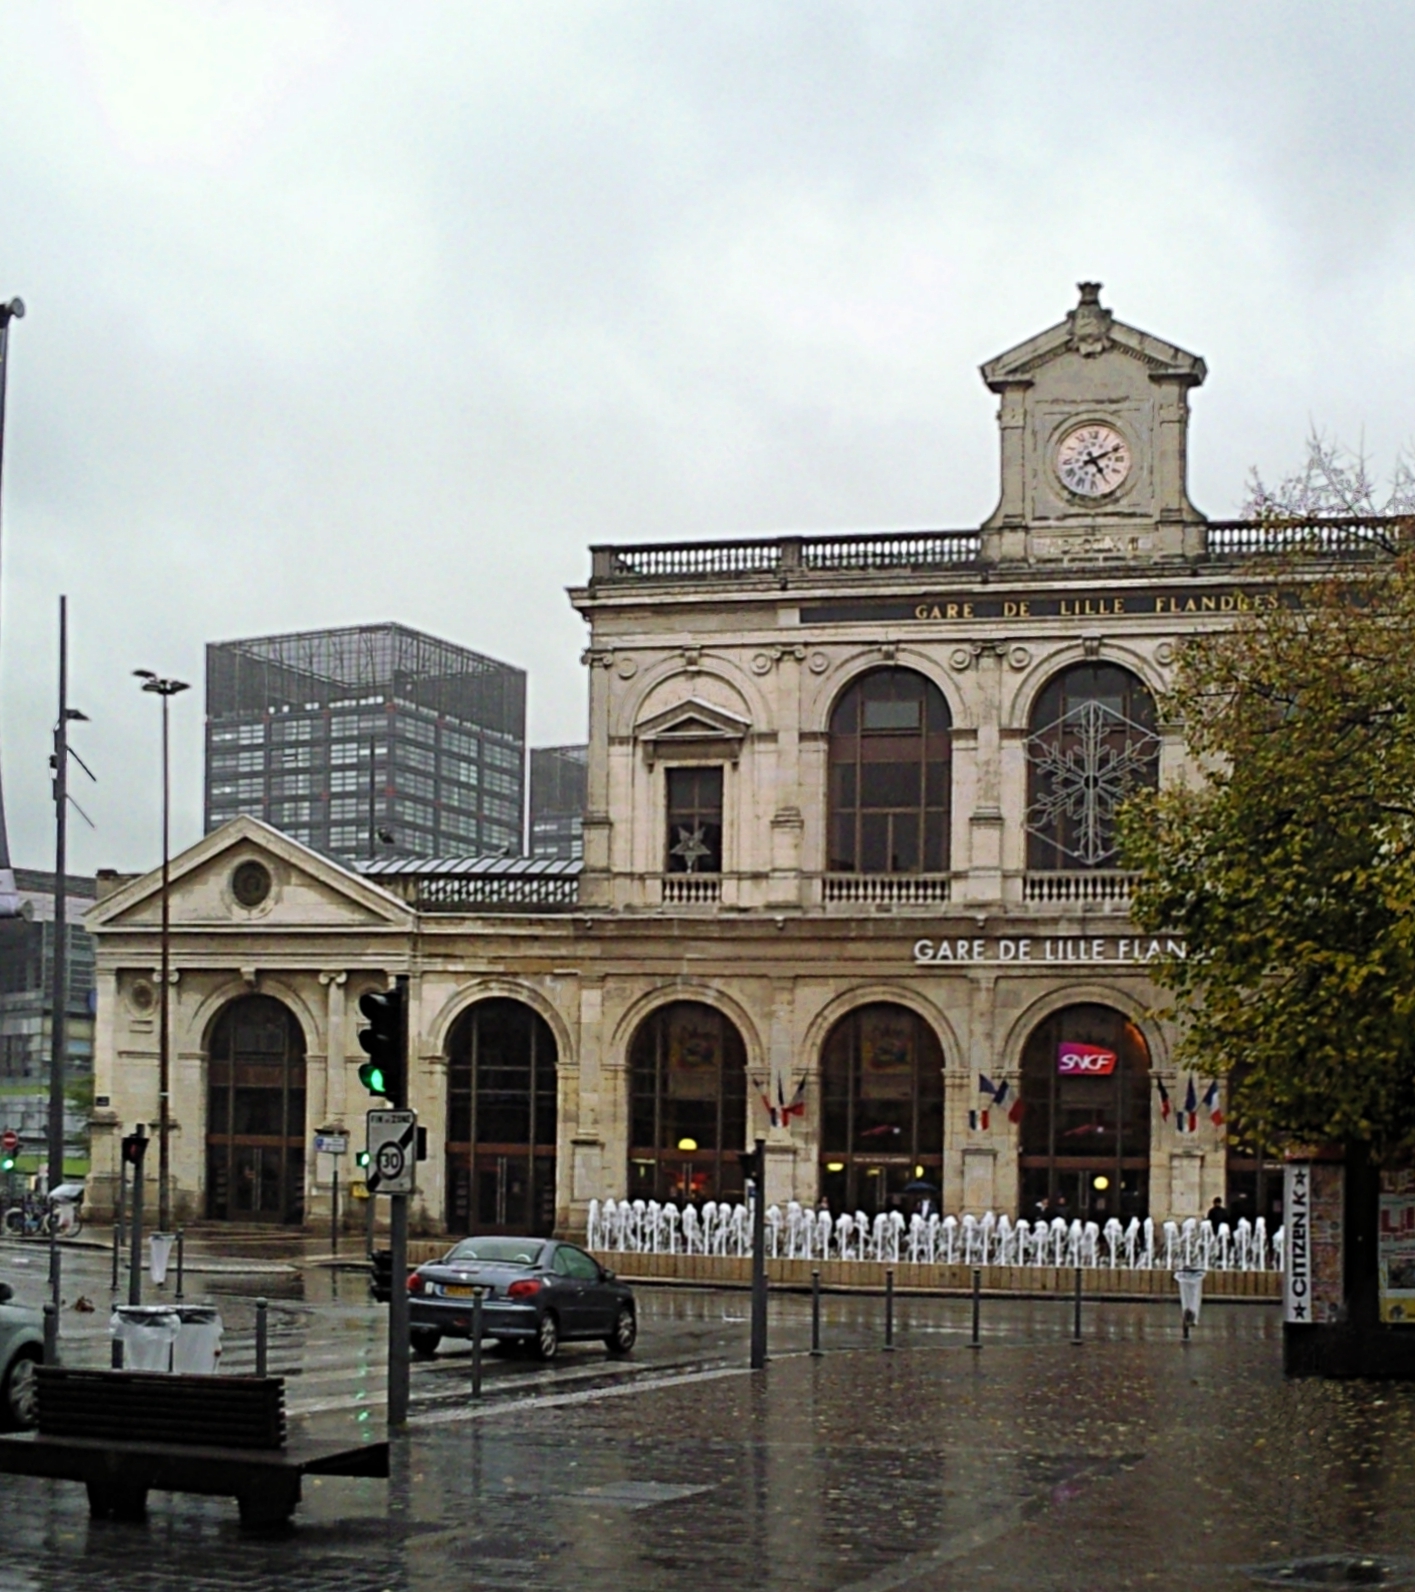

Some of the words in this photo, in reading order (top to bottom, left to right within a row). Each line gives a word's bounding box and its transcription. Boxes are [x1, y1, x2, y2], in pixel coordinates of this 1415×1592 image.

[914, 603, 974, 619] GARE
[1004, 601, 1030, 617] DE
[1060, 598, 1124, 615] LILLE
[914, 939, 985, 960] GARE
[999, 939, 1031, 960] DE
[1045, 939, 1105, 960] LILLE
[1059, 1053, 1114, 1070] SNCF
[381, 1153, 399, 1169] 30
[1292, 1190, 1307, 1207] K
[1292, 1212, 1307, 1298] CITIZEN
